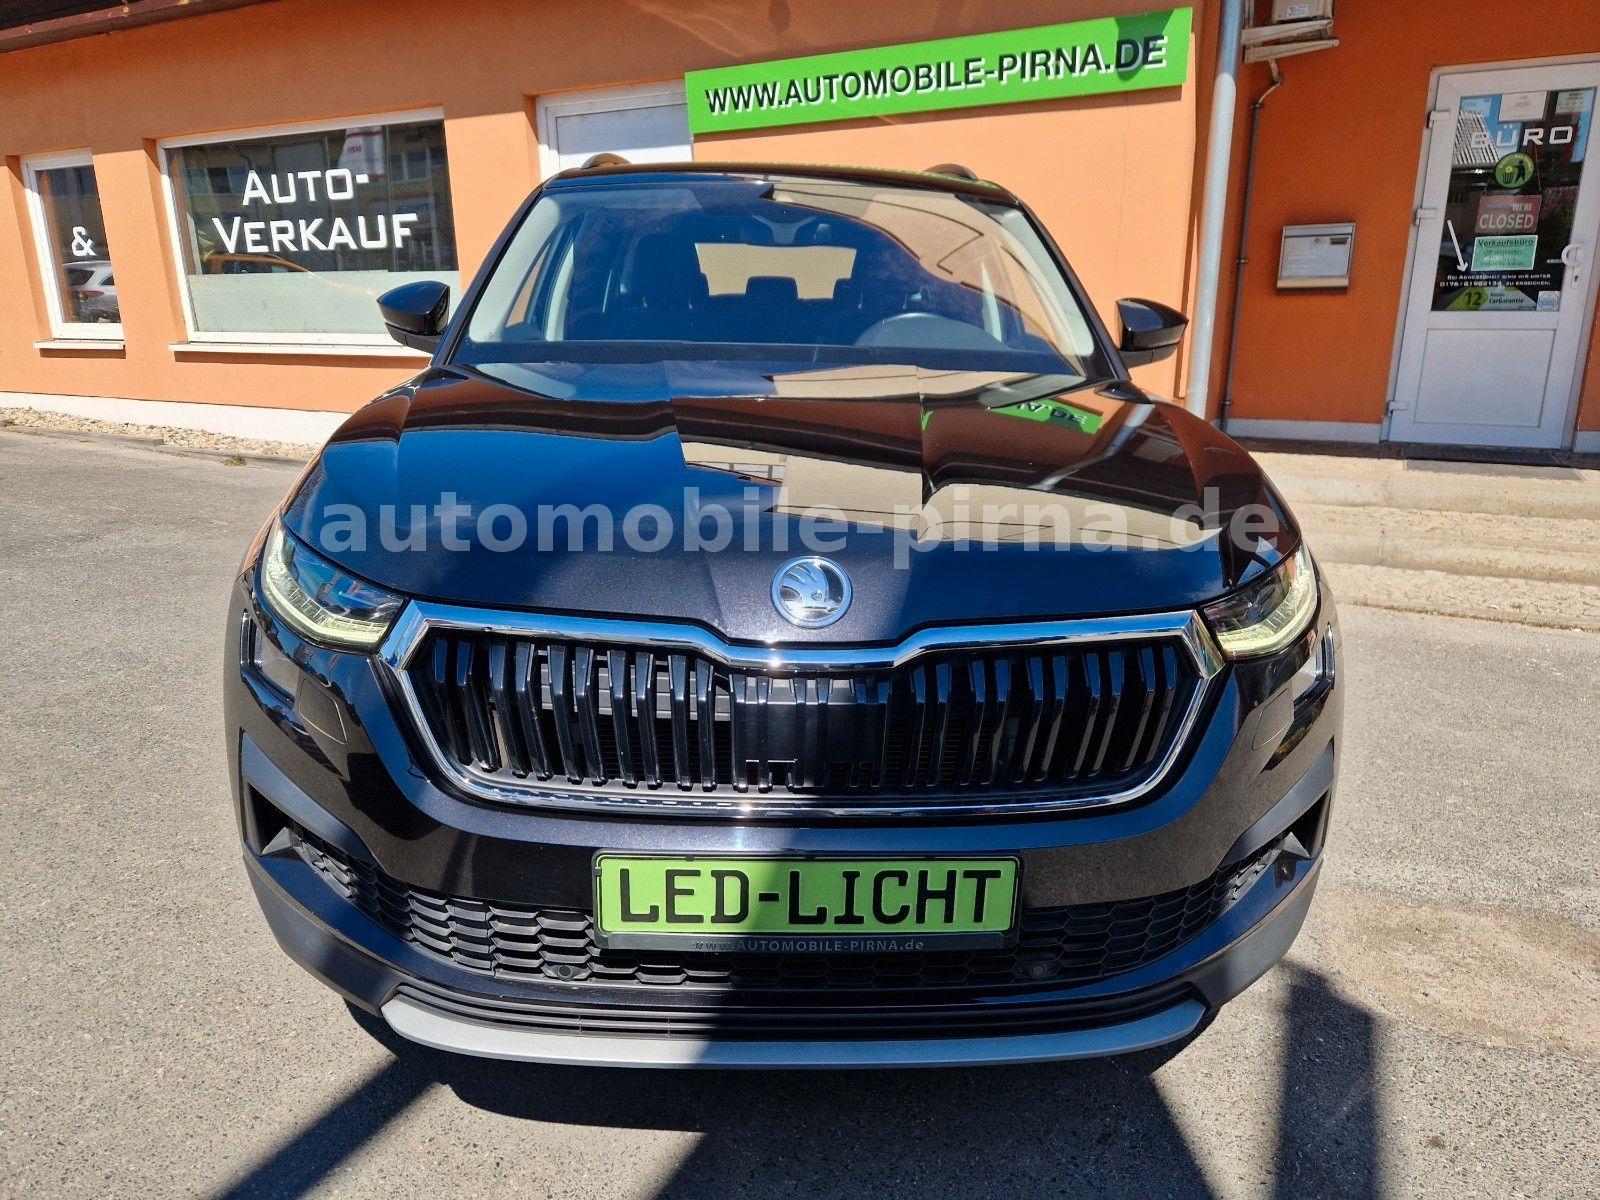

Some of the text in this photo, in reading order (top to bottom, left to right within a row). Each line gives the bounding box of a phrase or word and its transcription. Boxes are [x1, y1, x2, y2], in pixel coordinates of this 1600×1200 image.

[704, 35, 1168, 117] WWW.AUTOMOBILE-PIRNA.DE
[242, 168, 369, 206] AUTO-
[212, 213, 418, 254] VERKAUF
[1479, 213, 1535, 229] CLOSED
[71, 225, 96, 257] &
[1477, 237, 1535, 247] Verkaufsbüro
[1465, 291, 1482, 306] 12
[620, 868, 1002, 925] LED-LICHT
